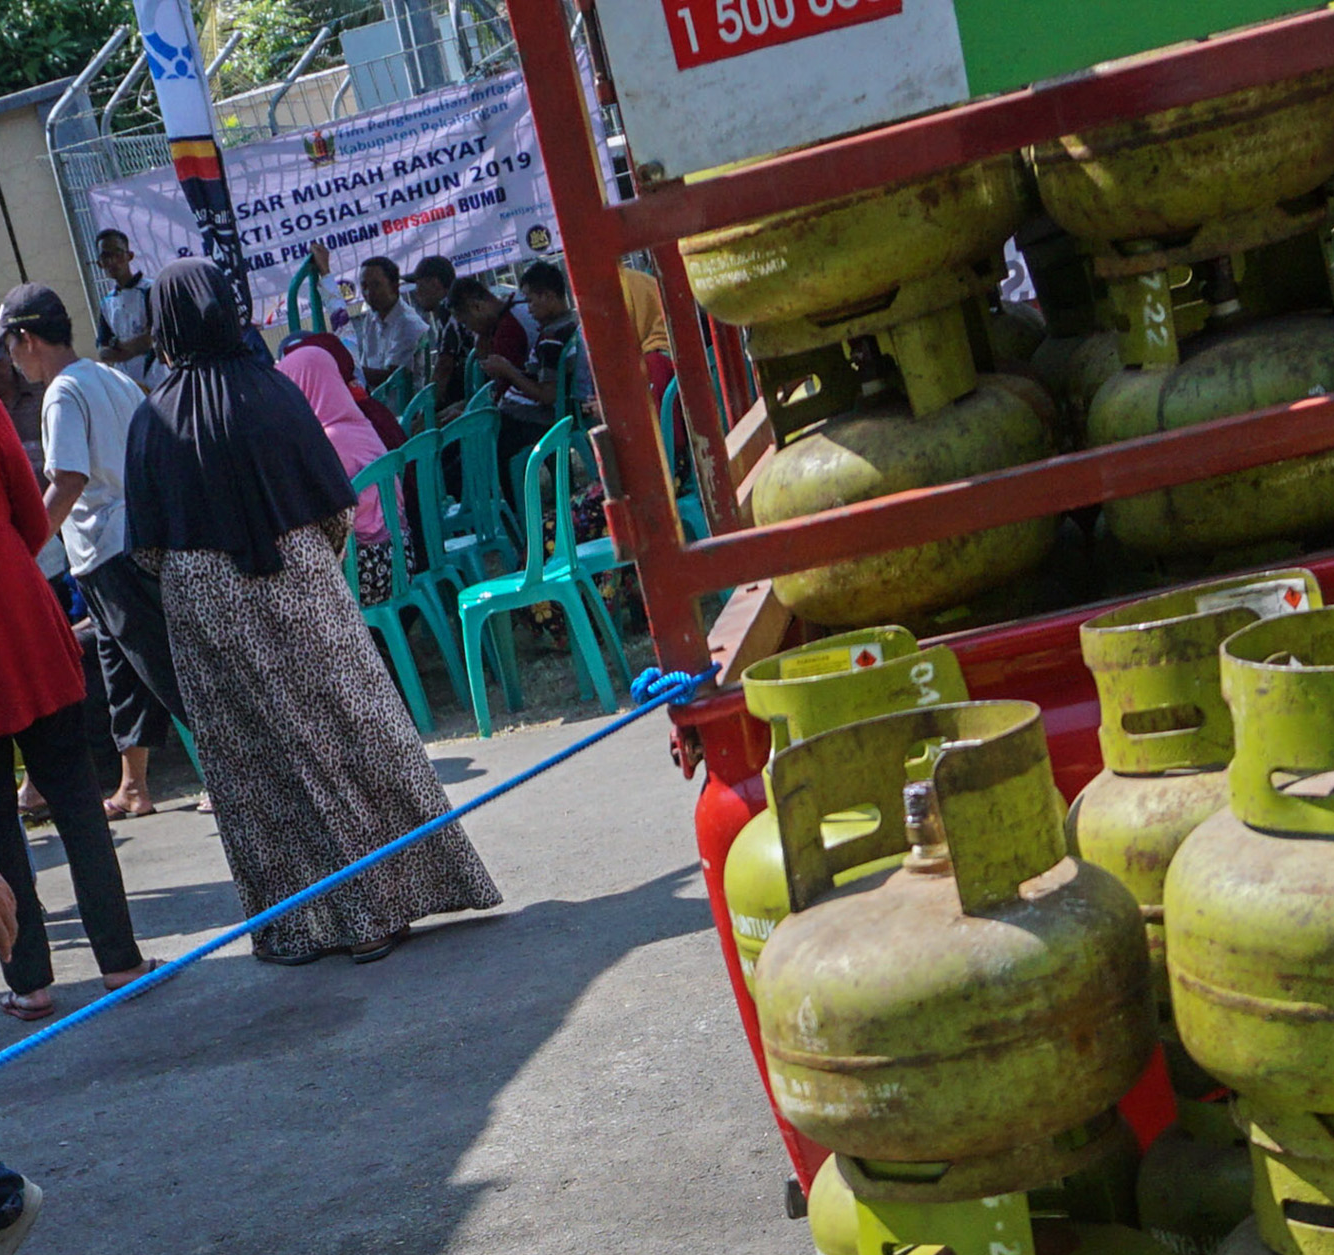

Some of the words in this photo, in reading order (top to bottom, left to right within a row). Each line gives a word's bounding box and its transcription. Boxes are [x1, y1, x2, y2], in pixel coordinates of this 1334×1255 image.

[280, 204, 370, 236] SOSIAL
[375, 171, 461, 211] TAHUN
[469, 150, 533, 184] 2019
[292, 166, 385, 207] MURAH
[393, 136, 487, 179] RAKYAT
[381, 204, 456, 236] Bersama
[458, 186, 508, 214] BUMD
